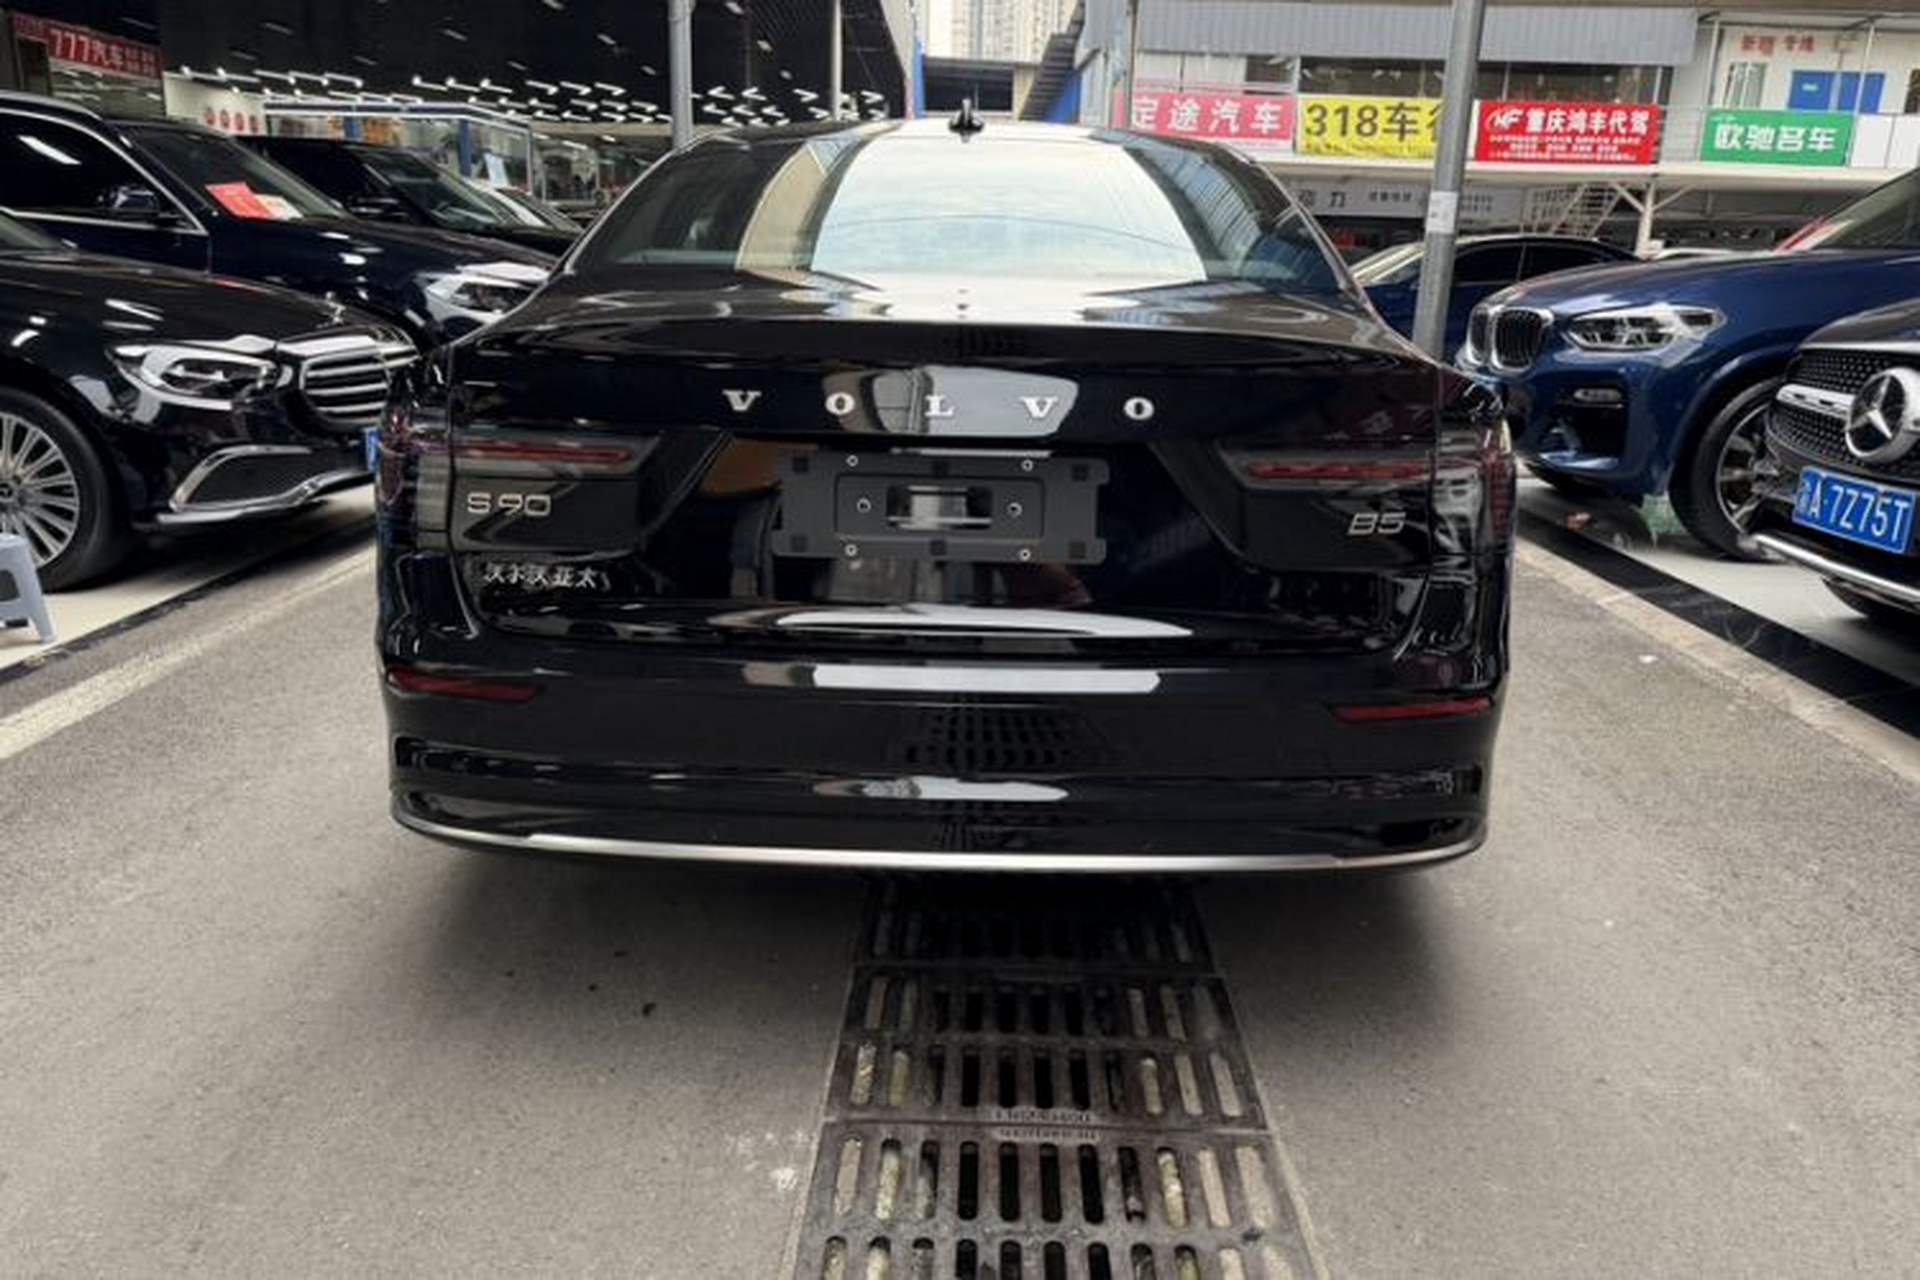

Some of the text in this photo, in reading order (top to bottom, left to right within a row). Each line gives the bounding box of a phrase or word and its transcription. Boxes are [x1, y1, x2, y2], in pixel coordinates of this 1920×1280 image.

[1714, 124, 1838, 152] 欧驰名车
[722, 389, 1156, 420] VOLVO
[467, 492, 552, 517] S90
[1348, 512, 1406, 535] B5
